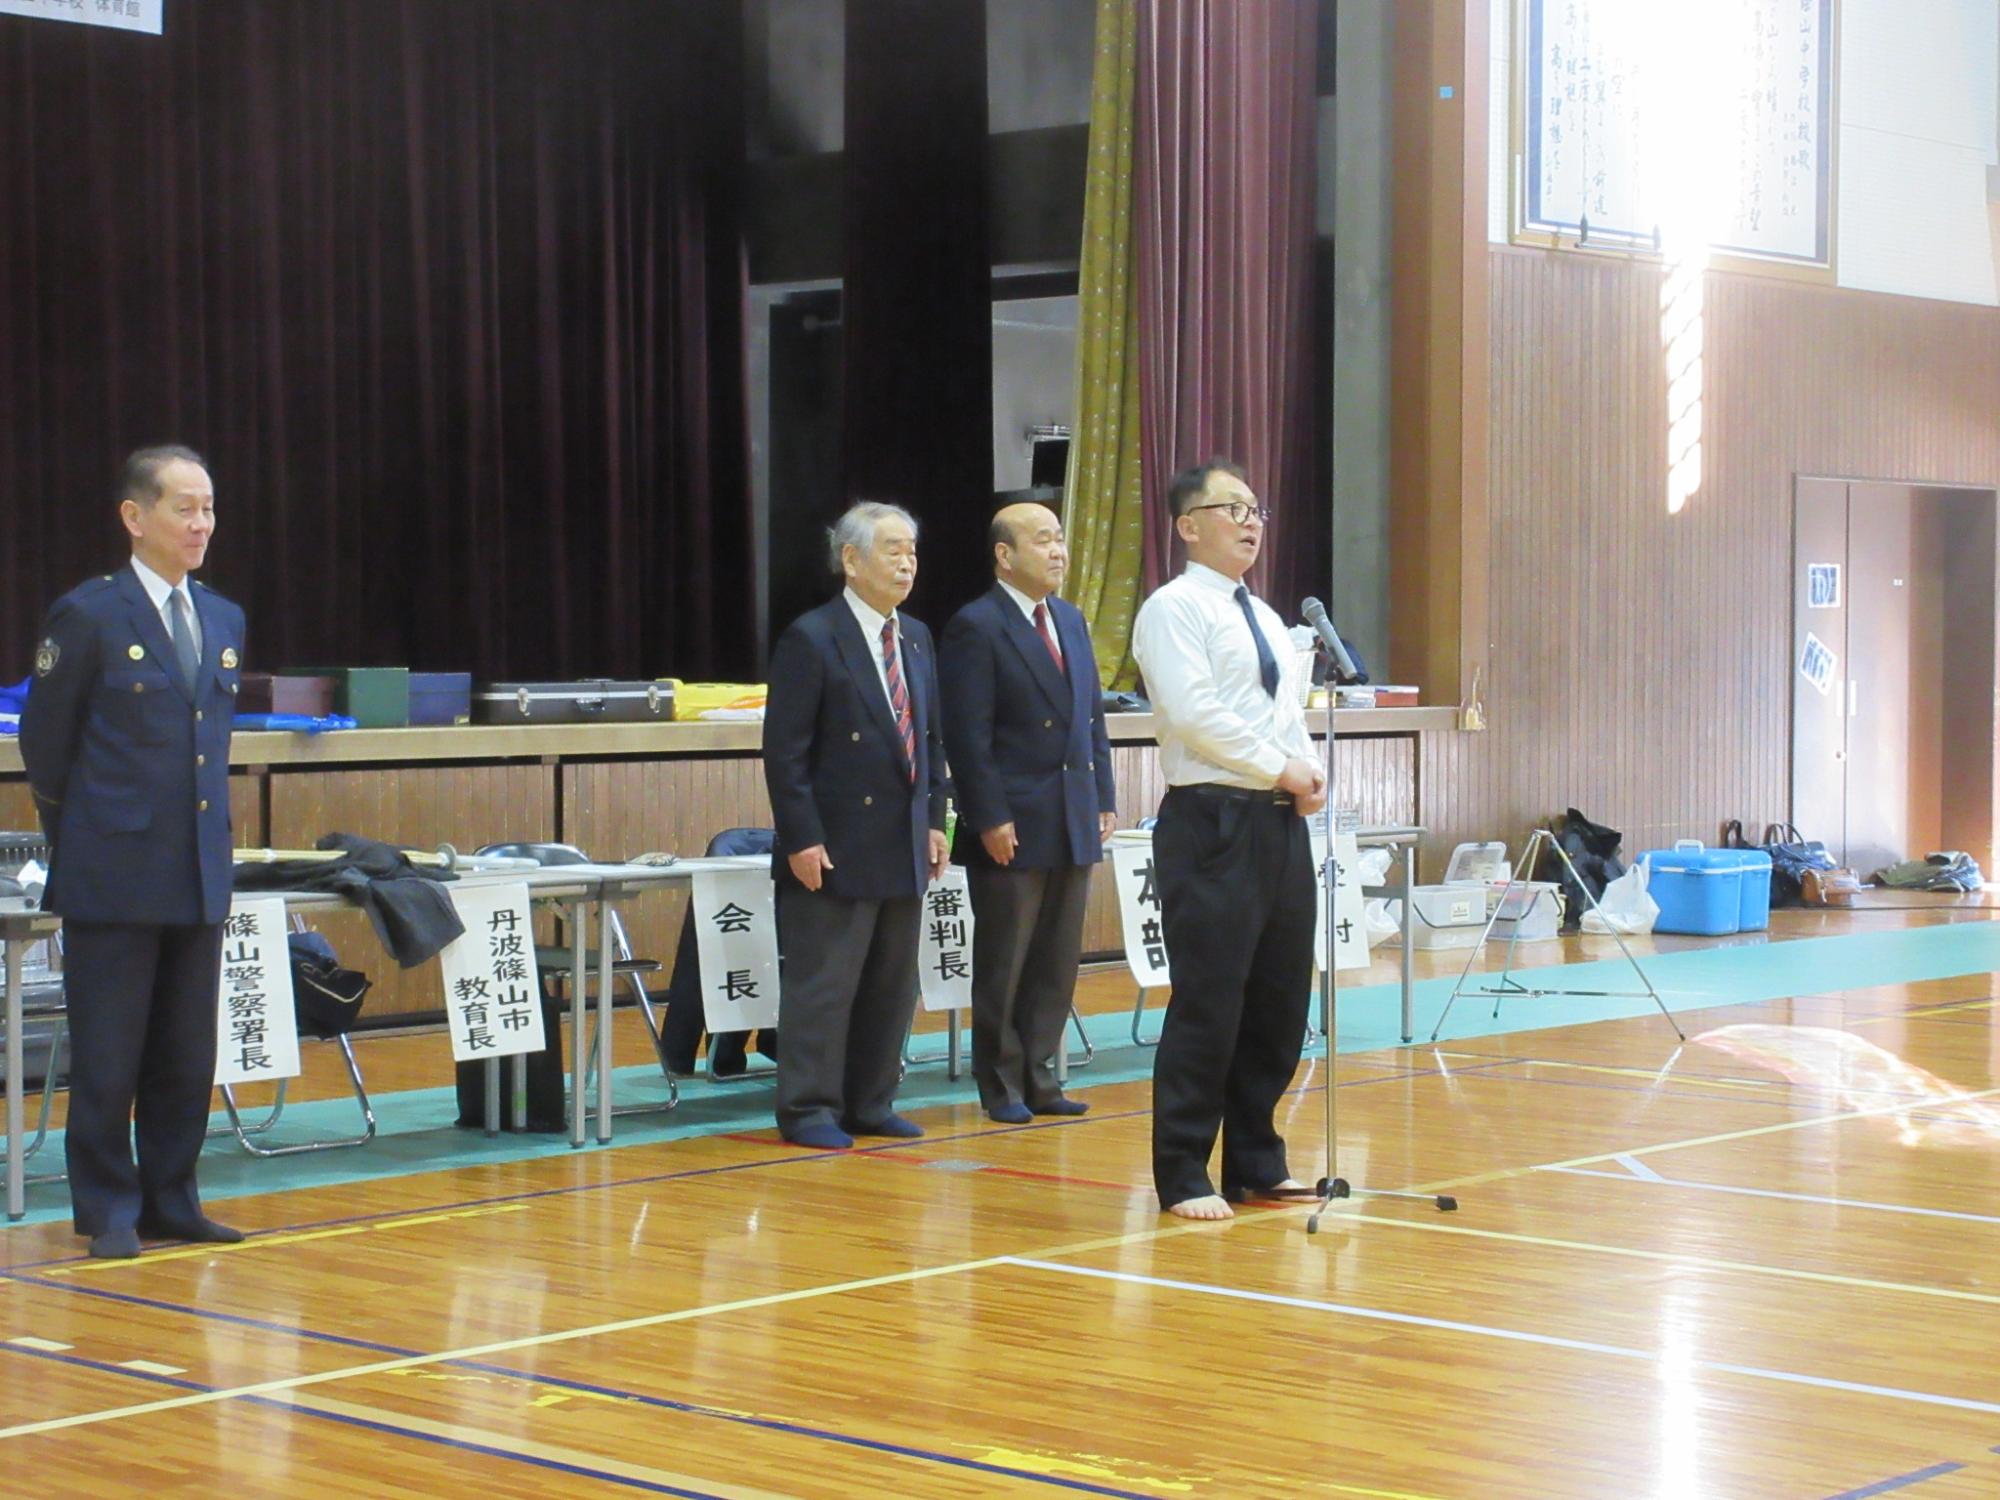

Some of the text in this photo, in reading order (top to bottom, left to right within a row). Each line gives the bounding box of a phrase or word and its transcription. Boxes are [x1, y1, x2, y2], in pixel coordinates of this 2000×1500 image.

[487, 908, 533, 1032] 丹波篠山市
[712, 902, 761, 1002] 会長
[927, 887, 970, 981] 審判長
[223, 912, 273, 1072] 篠山警察署長
[454, 975, 499, 1051] 教育長
